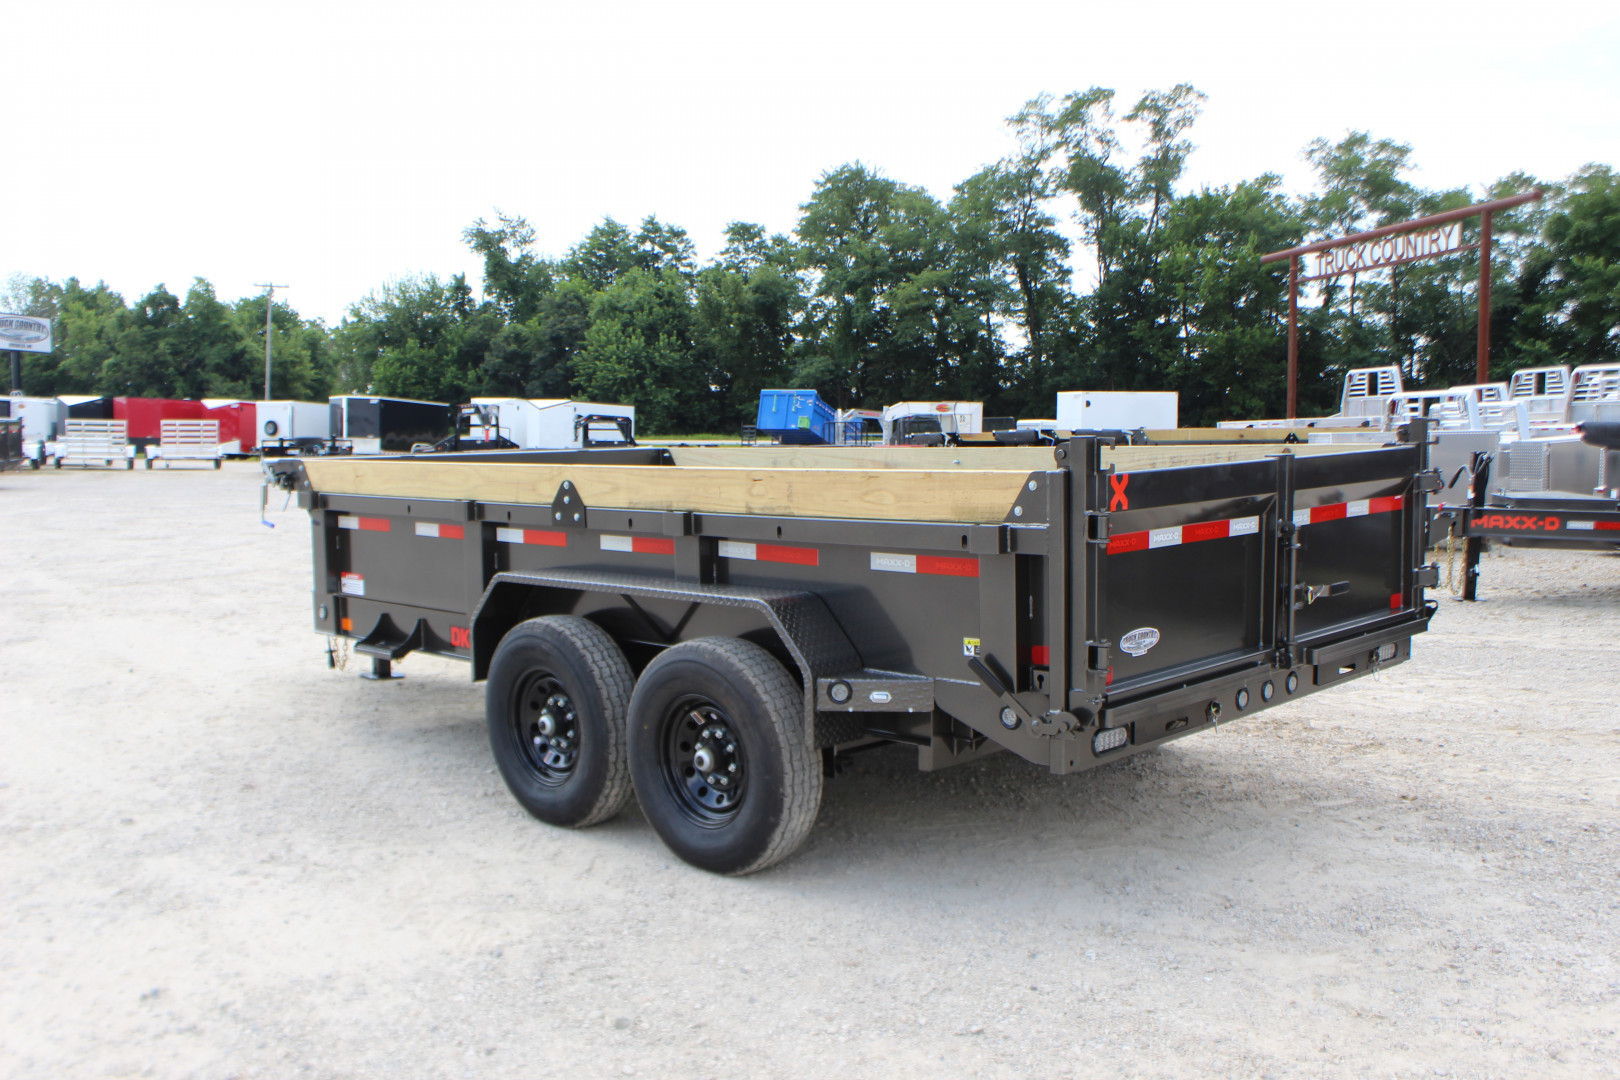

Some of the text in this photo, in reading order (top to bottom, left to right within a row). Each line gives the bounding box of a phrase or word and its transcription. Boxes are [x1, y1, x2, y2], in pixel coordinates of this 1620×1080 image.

[1315, 223, 1456, 276] TRUCK COUNTRY
[1110, 473, 1129, 512] X
[1232, 520, 1256, 531] MAXX-D
[1470, 515, 1560, 531] MAXX-D
[1153, 532, 1179, 543] MAXX-D
[876, 558, 911, 568] MAXX-D
